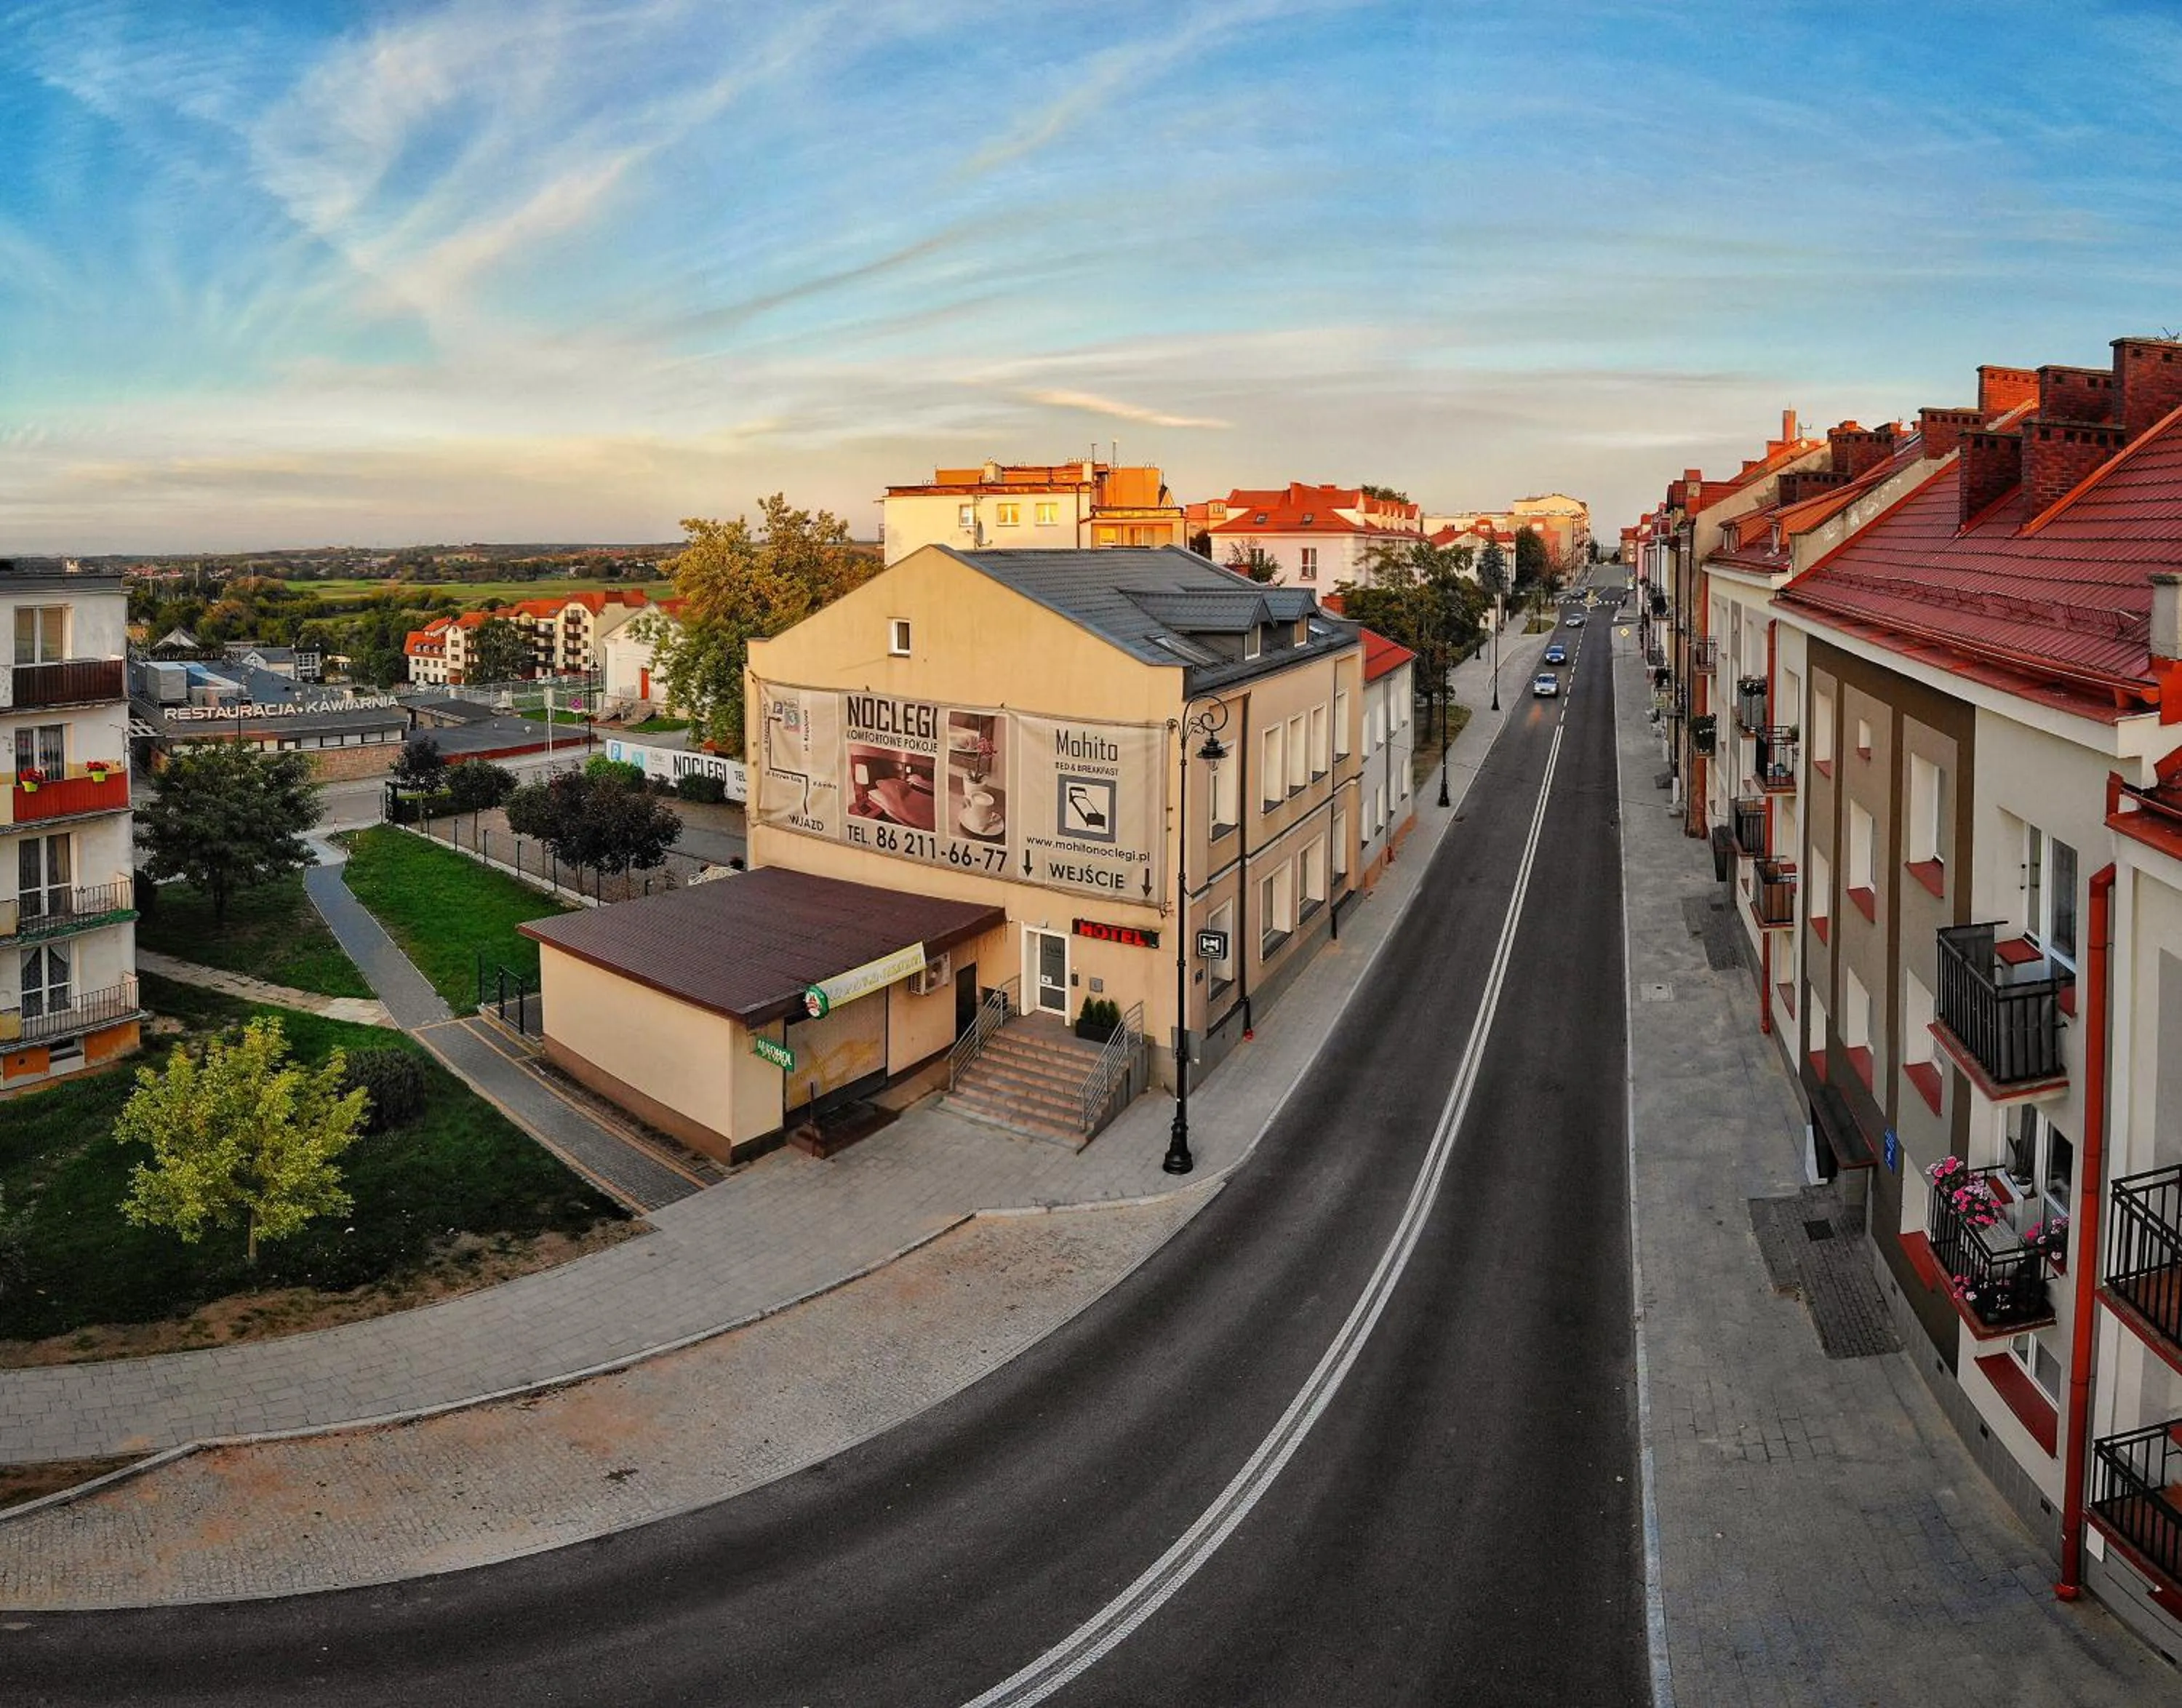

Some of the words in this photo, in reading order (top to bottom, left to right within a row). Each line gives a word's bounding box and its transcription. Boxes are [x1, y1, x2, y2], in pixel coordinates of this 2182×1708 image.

[305, 695, 399, 714] KAWIARNIA
[847, 695, 938, 740] NOCLEGI
[1056, 729, 1118, 762] Mohito
[788, 815, 824, 831] WJAZD
[847, 825, 871, 845] TEL.
[876, 826, 898, 850] 86
[904, 832, 1007, 872] 211-66-77
[1027, 836, 1151, 863] www.mohitonoclegi.pl
[1049, 862, 1125, 889] WEJŚCIE
